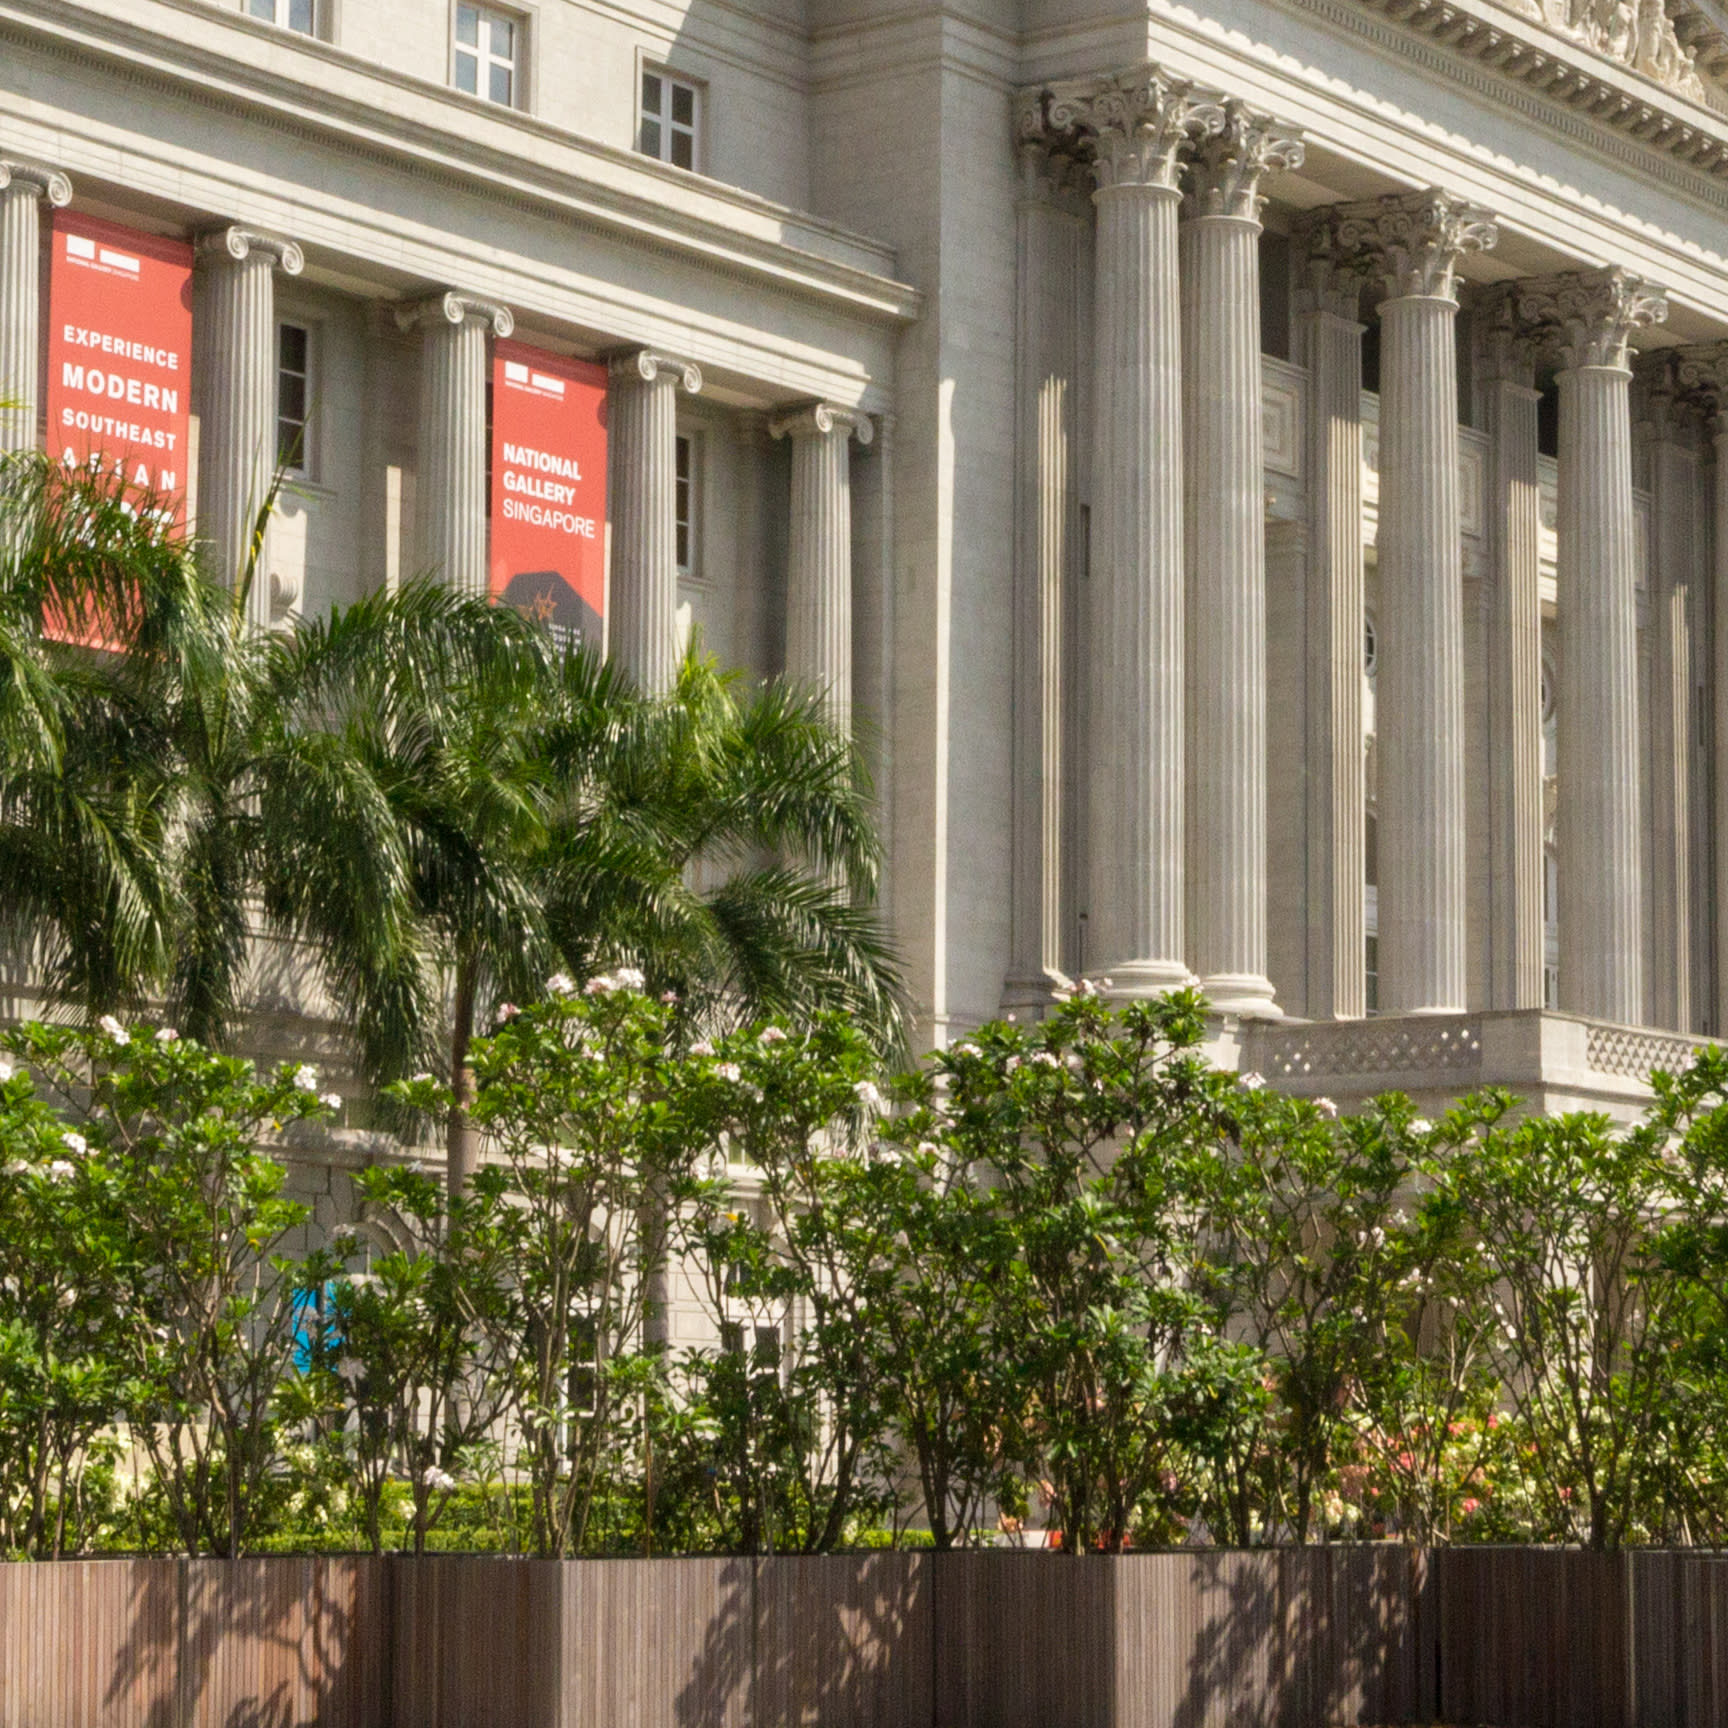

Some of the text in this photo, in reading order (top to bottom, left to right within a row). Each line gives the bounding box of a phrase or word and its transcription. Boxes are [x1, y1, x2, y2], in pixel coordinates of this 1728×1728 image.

[63, 324, 178, 370] EXPERIENCE
[62, 362, 178, 414] MODERN
[61, 408, 176, 451] SOUTHEAST
[62, 446, 176, 491] ASIAN
[503, 442, 582, 481] NATIONAL
[503, 470, 576, 506] GALLERY
[503, 498, 595, 539] SINGAPORE
